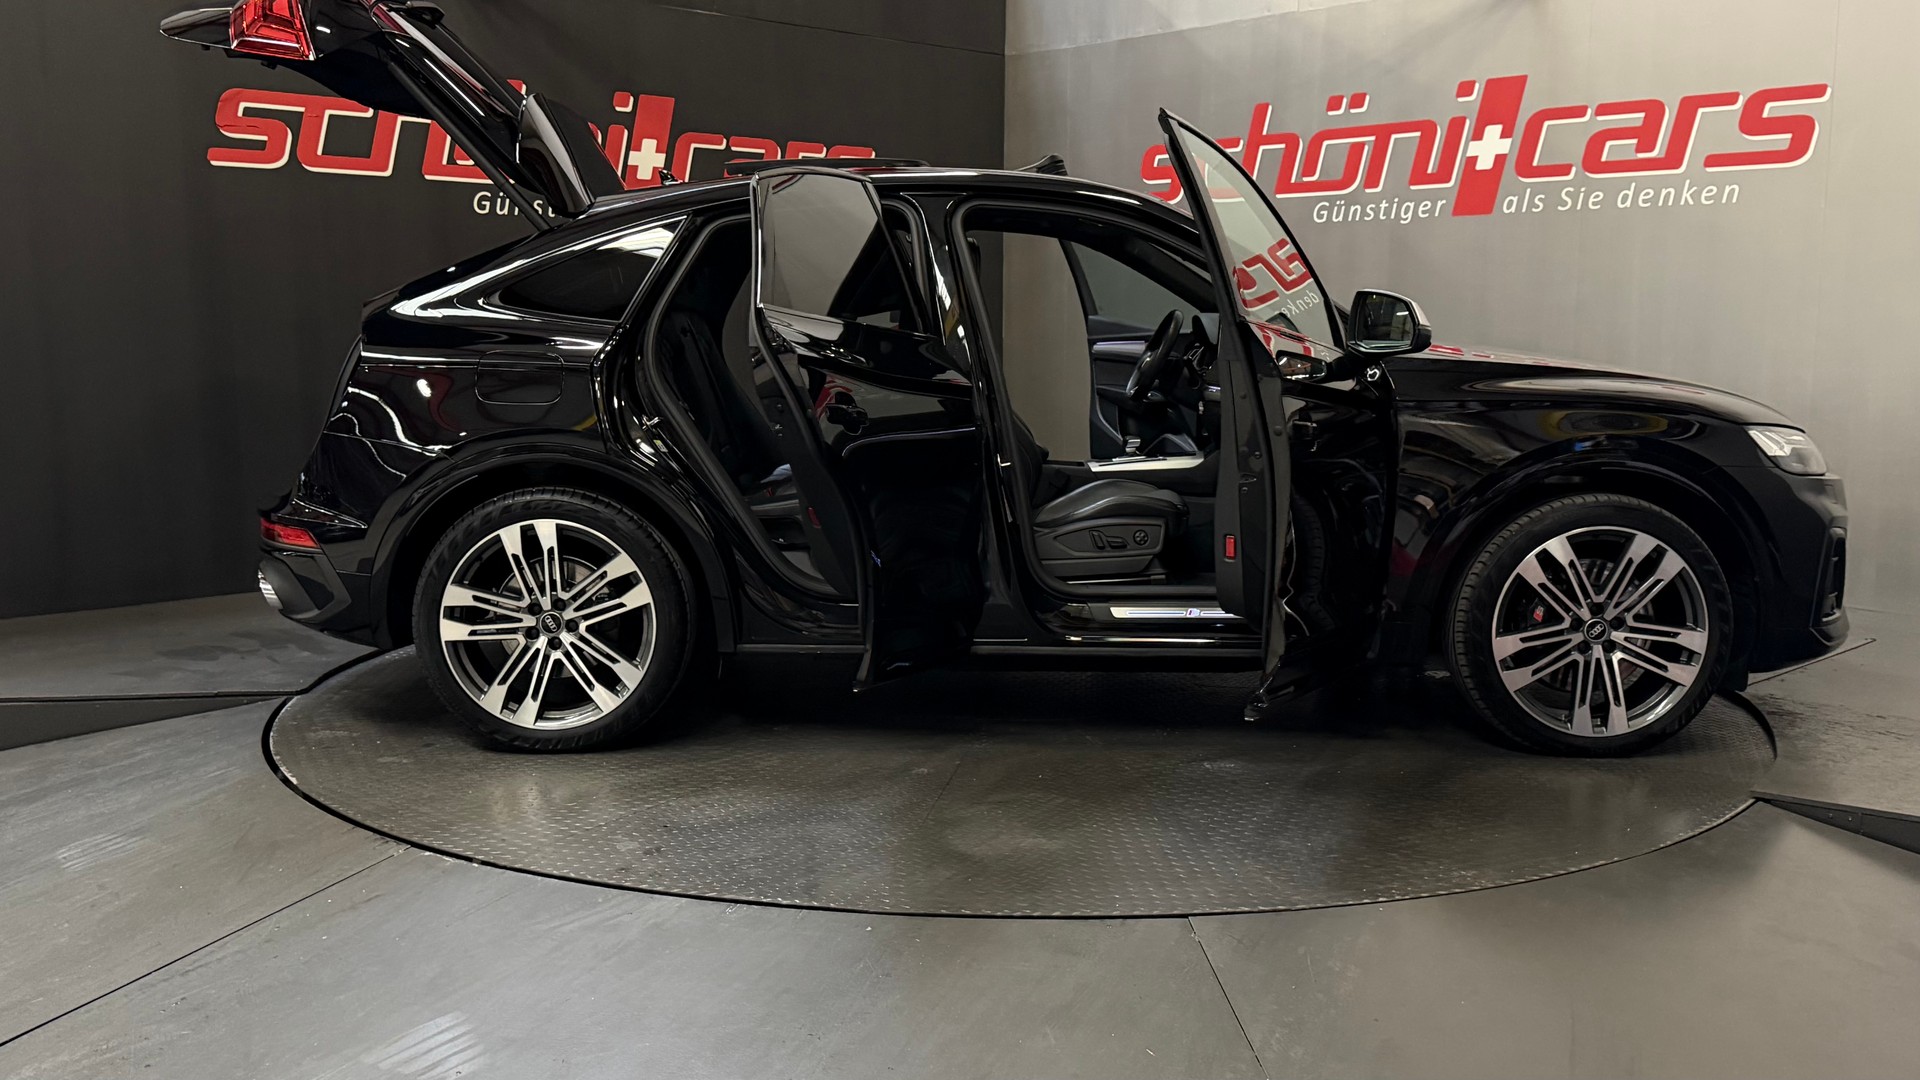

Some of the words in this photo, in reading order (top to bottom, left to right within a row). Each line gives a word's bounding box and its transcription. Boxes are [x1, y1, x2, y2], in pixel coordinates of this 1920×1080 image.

[1313, 197, 1446, 224] Günstiger
[1502, 188, 1545, 213] als
[1557, 186, 1604, 211] Sie
[1616, 179, 1740, 208] denken
